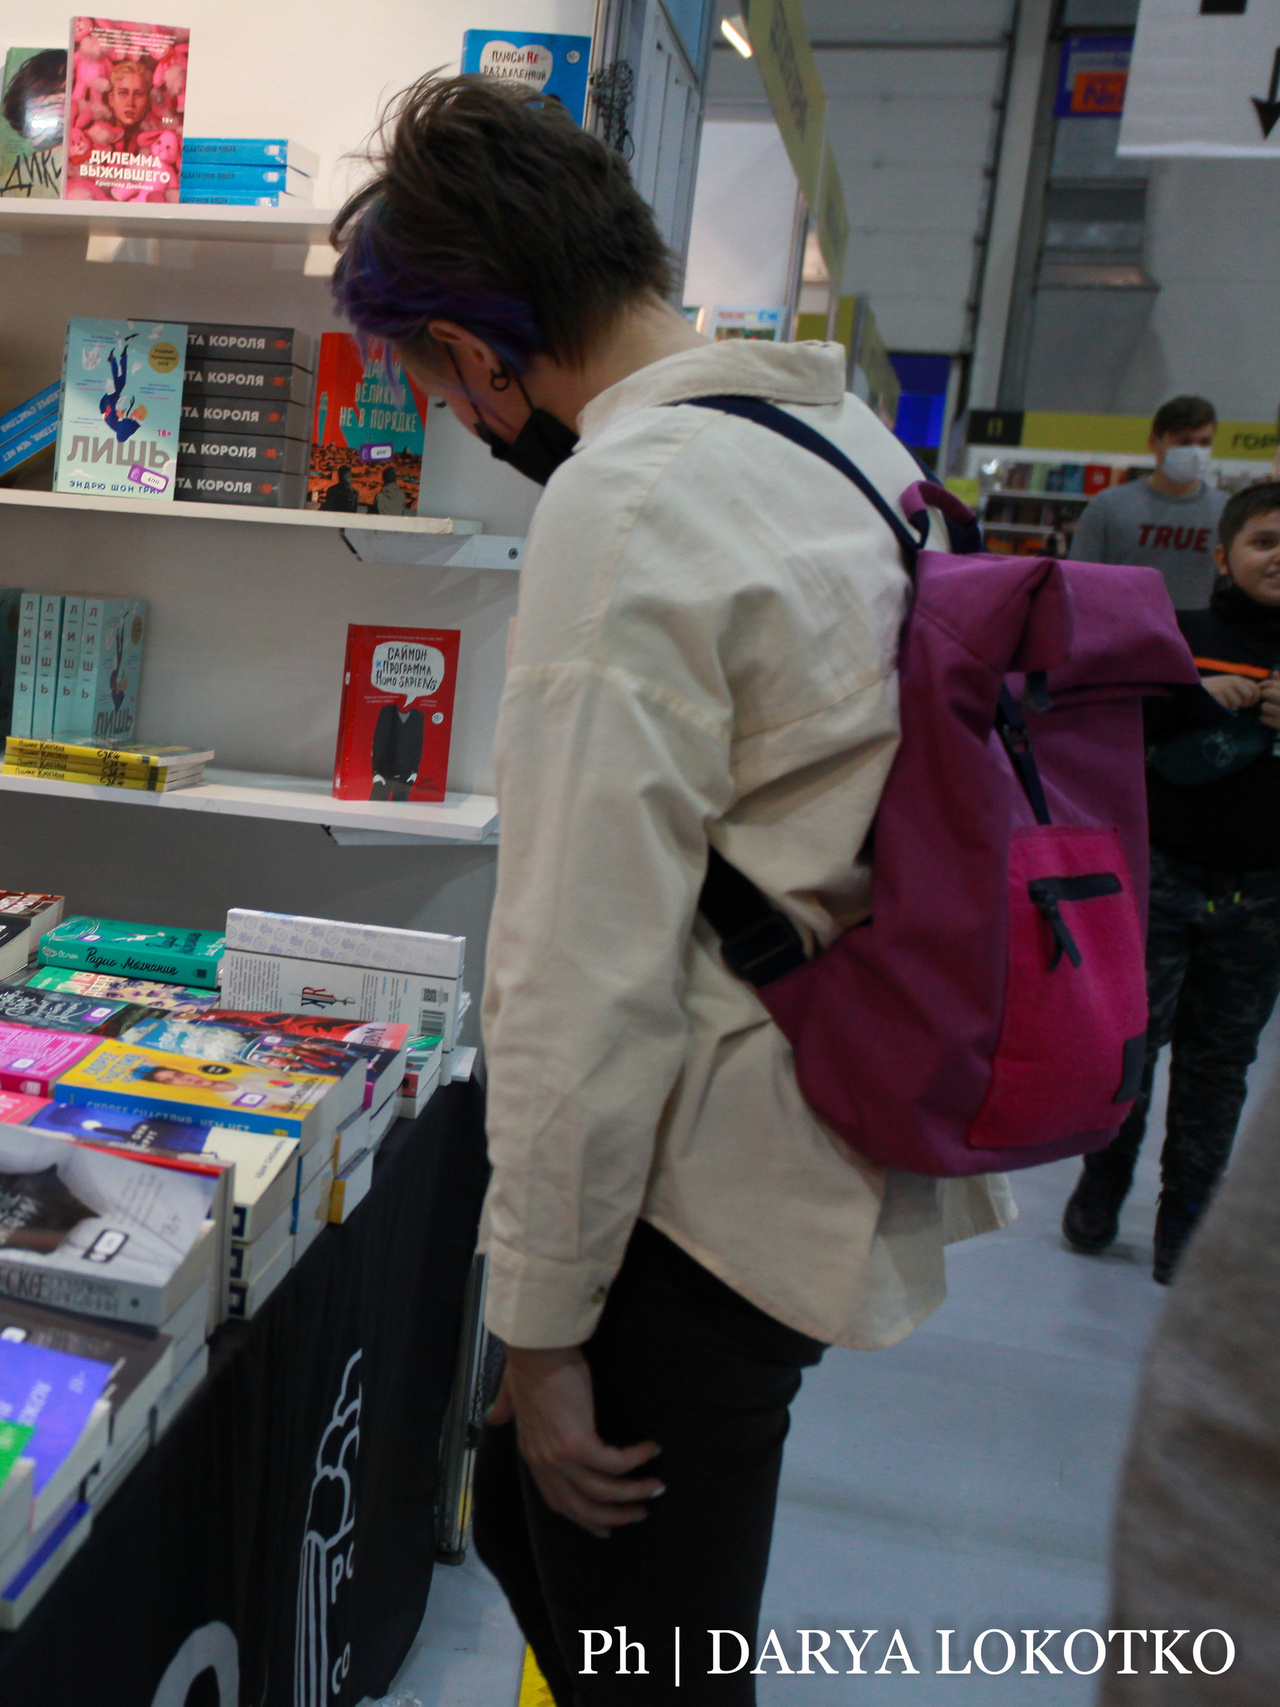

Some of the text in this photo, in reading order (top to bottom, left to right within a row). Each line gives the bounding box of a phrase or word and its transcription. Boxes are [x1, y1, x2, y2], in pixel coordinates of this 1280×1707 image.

[89, 149, 162, 170] ДИЛЕММА
[79, 164, 171, 185] ВЫЖИВШЕГО
[209, 335, 266, 350] КОРОЛЯ
[207, 372, 265, 387] КОРОЛЯ
[203, 407, 260, 423] КОРОЛЯ
[339, 406, 418, 433] НЕ В ПОРЯДКЕ
[157, 429, 172, 438] 18+
[66, 435, 170, 469] ЛИШЬ
[201, 444, 257, 459] КОРОЛЯ
[69, 480, 135, 493] ЭНДРЮ ШОН
[196, 479, 253, 494] КОРОЛЯ
[1137, 523, 1213, 554] TRUE
[387, 644, 428, 661] САЙМОН
[382, 660, 432, 676] ПРОГРАММА
[94, 709, 134, 736] ЛИШЬ
[86, 946, 117, 969] Радио
[120, 956, 179, 977] Молчание
